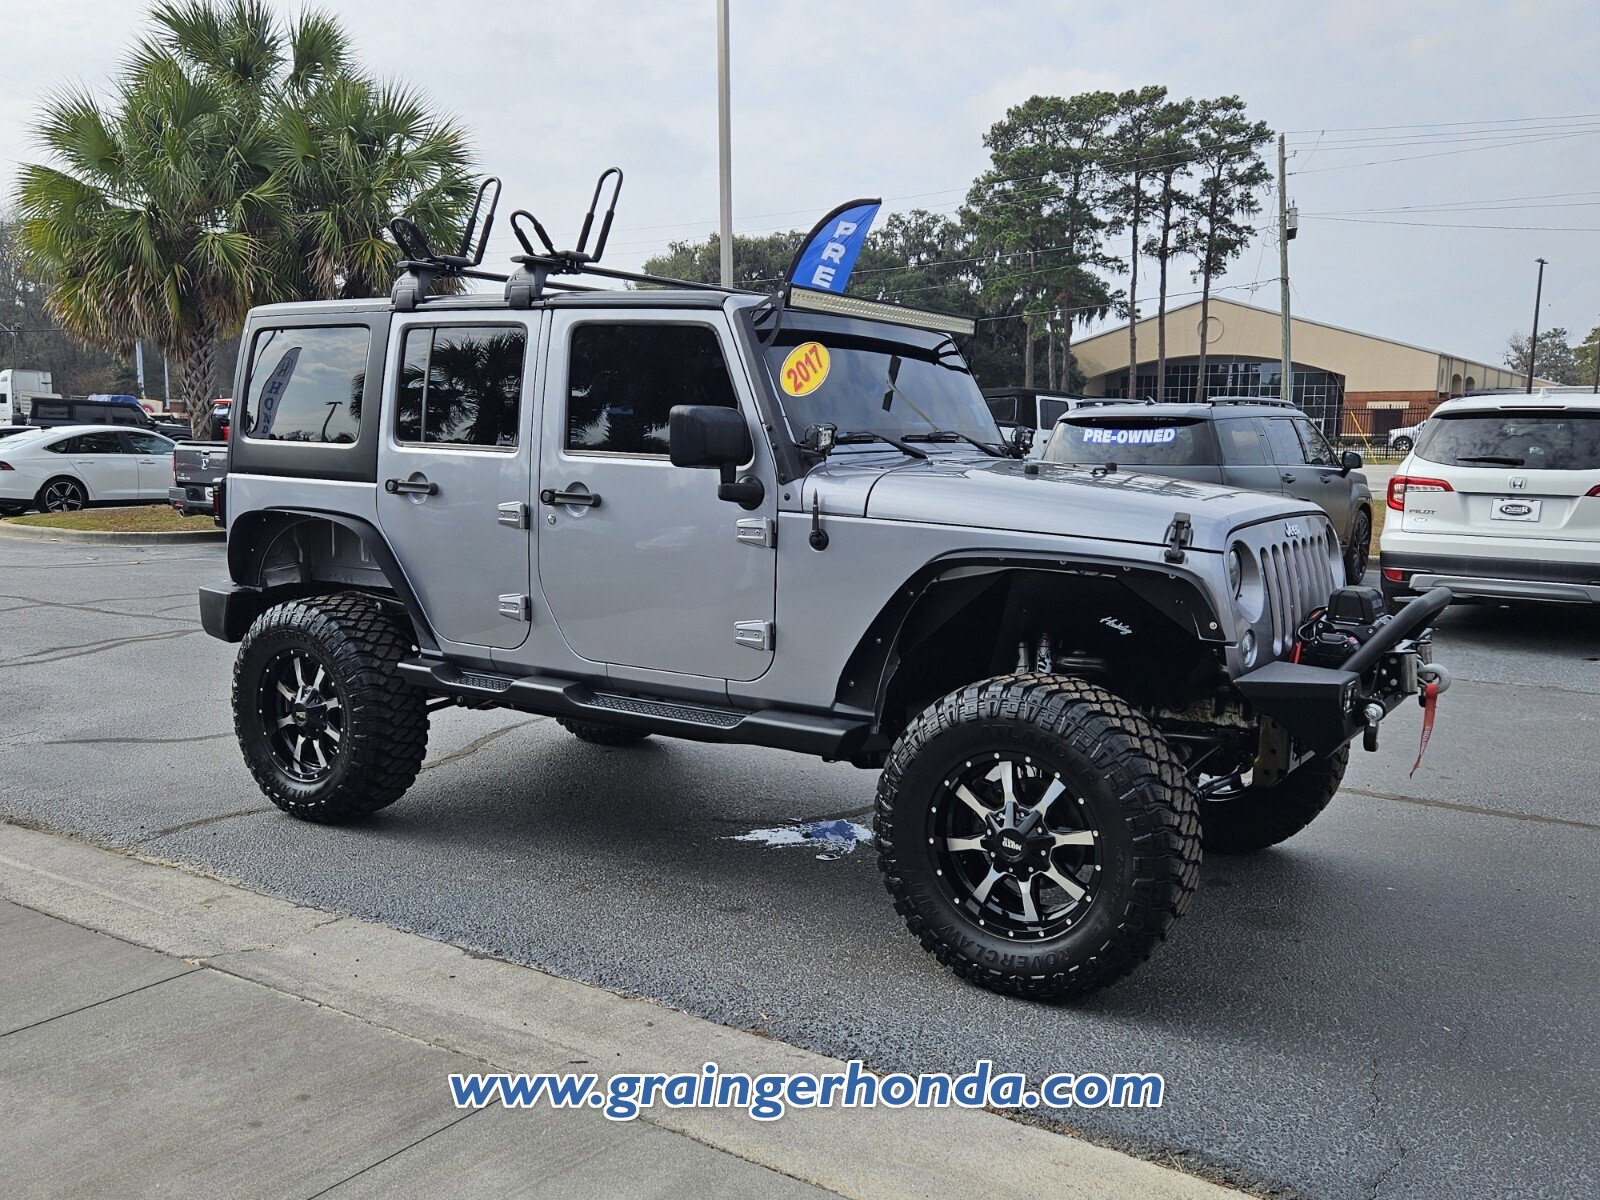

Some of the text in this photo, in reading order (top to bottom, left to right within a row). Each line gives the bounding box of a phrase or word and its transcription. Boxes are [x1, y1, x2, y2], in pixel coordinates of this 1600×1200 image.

[811, 220, 858, 289] PRE
[786, 344, 825, 393] 2017
[1083, 428, 1176, 444] PRE-OWNED
[939, 924, 1072, 969] ROVERCLAW
